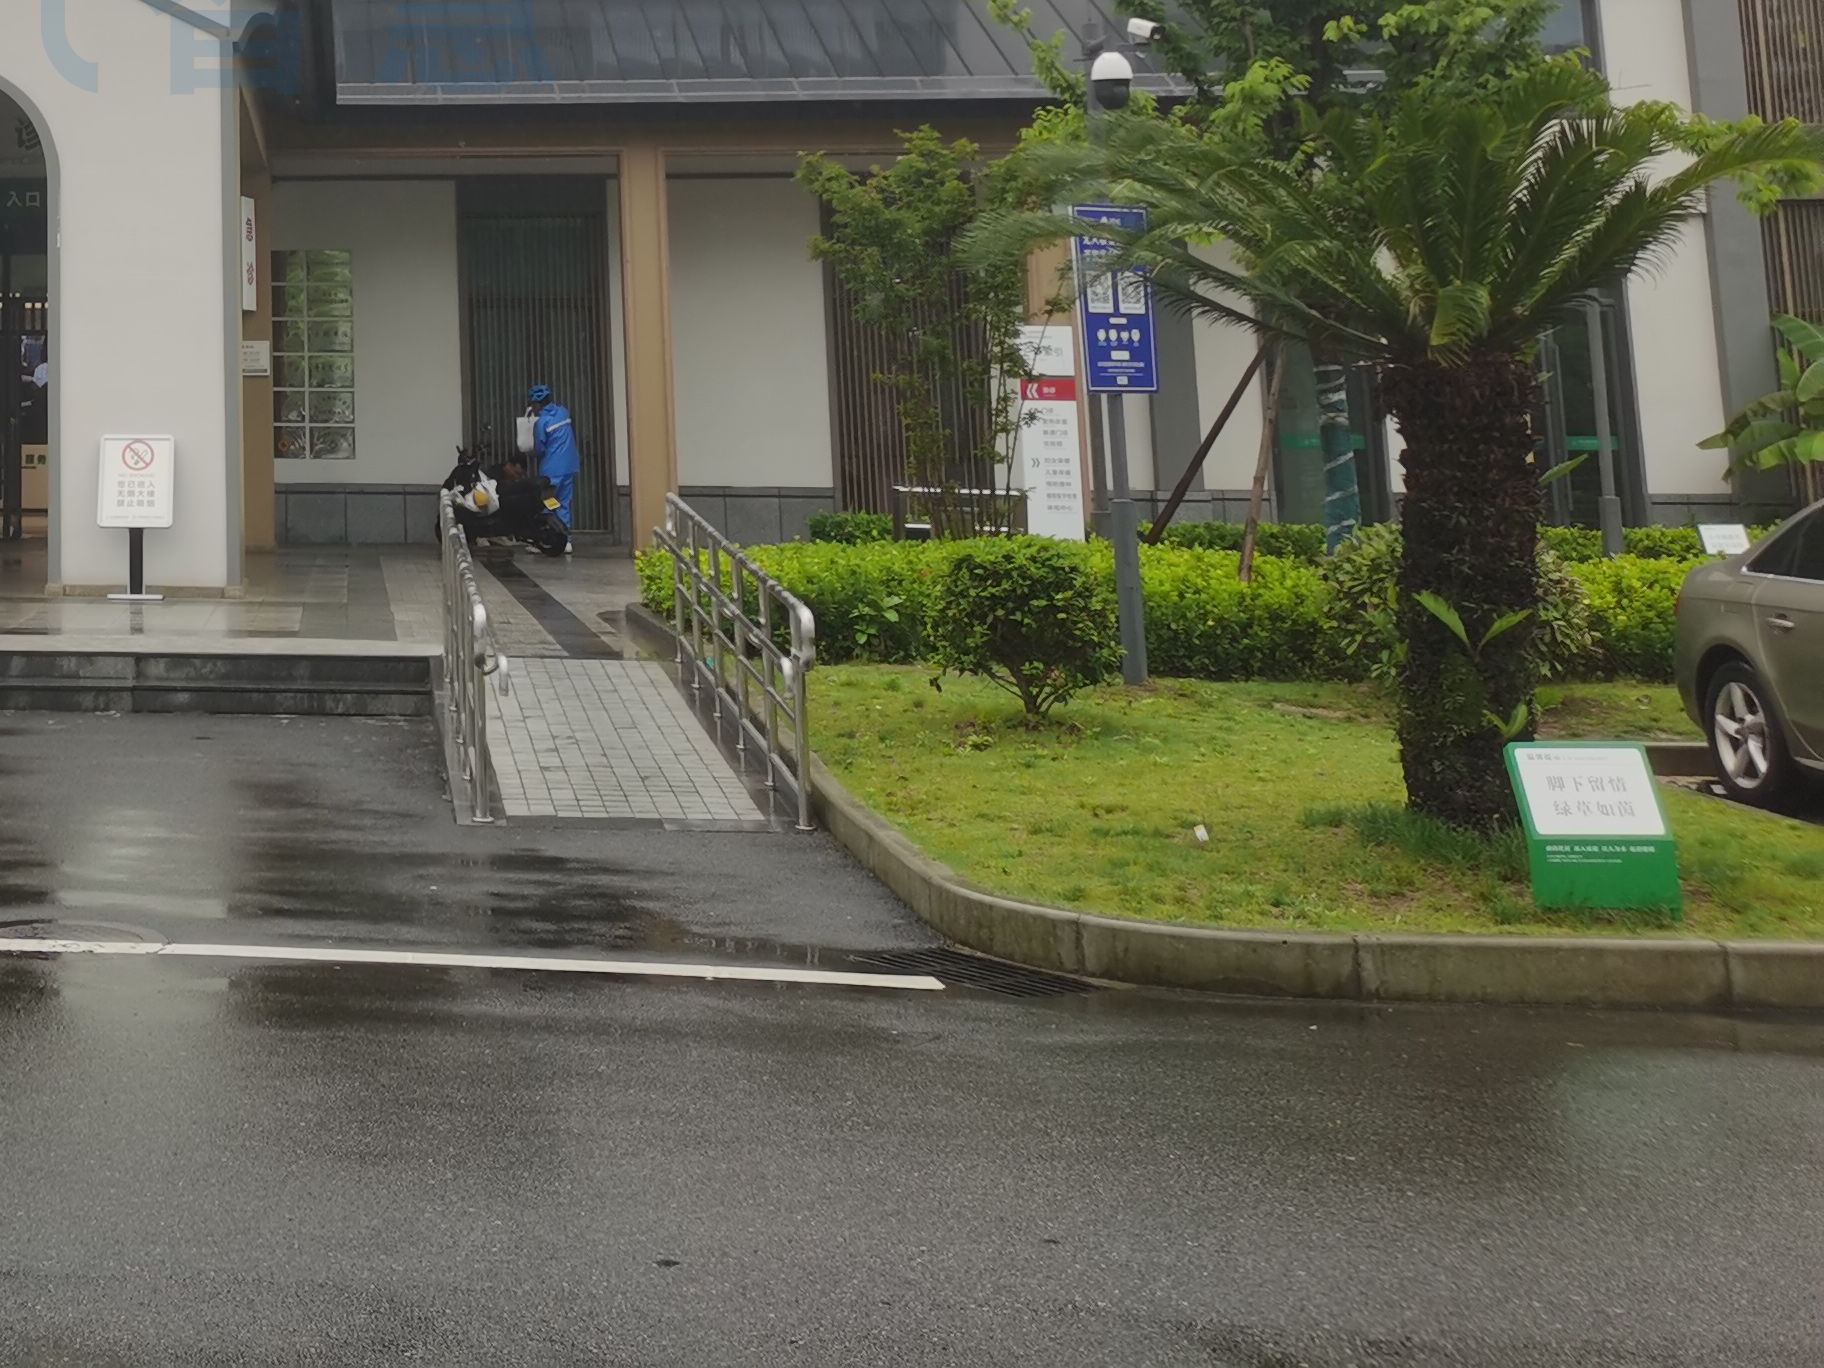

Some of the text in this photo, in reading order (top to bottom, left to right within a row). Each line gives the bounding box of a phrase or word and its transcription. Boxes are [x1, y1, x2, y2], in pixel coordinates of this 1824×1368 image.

[6, 191, 40, 208] 入口
[1545, 775, 1627, 793] 脚下留情
[1553, 800, 1636, 817] 绿草如茵
